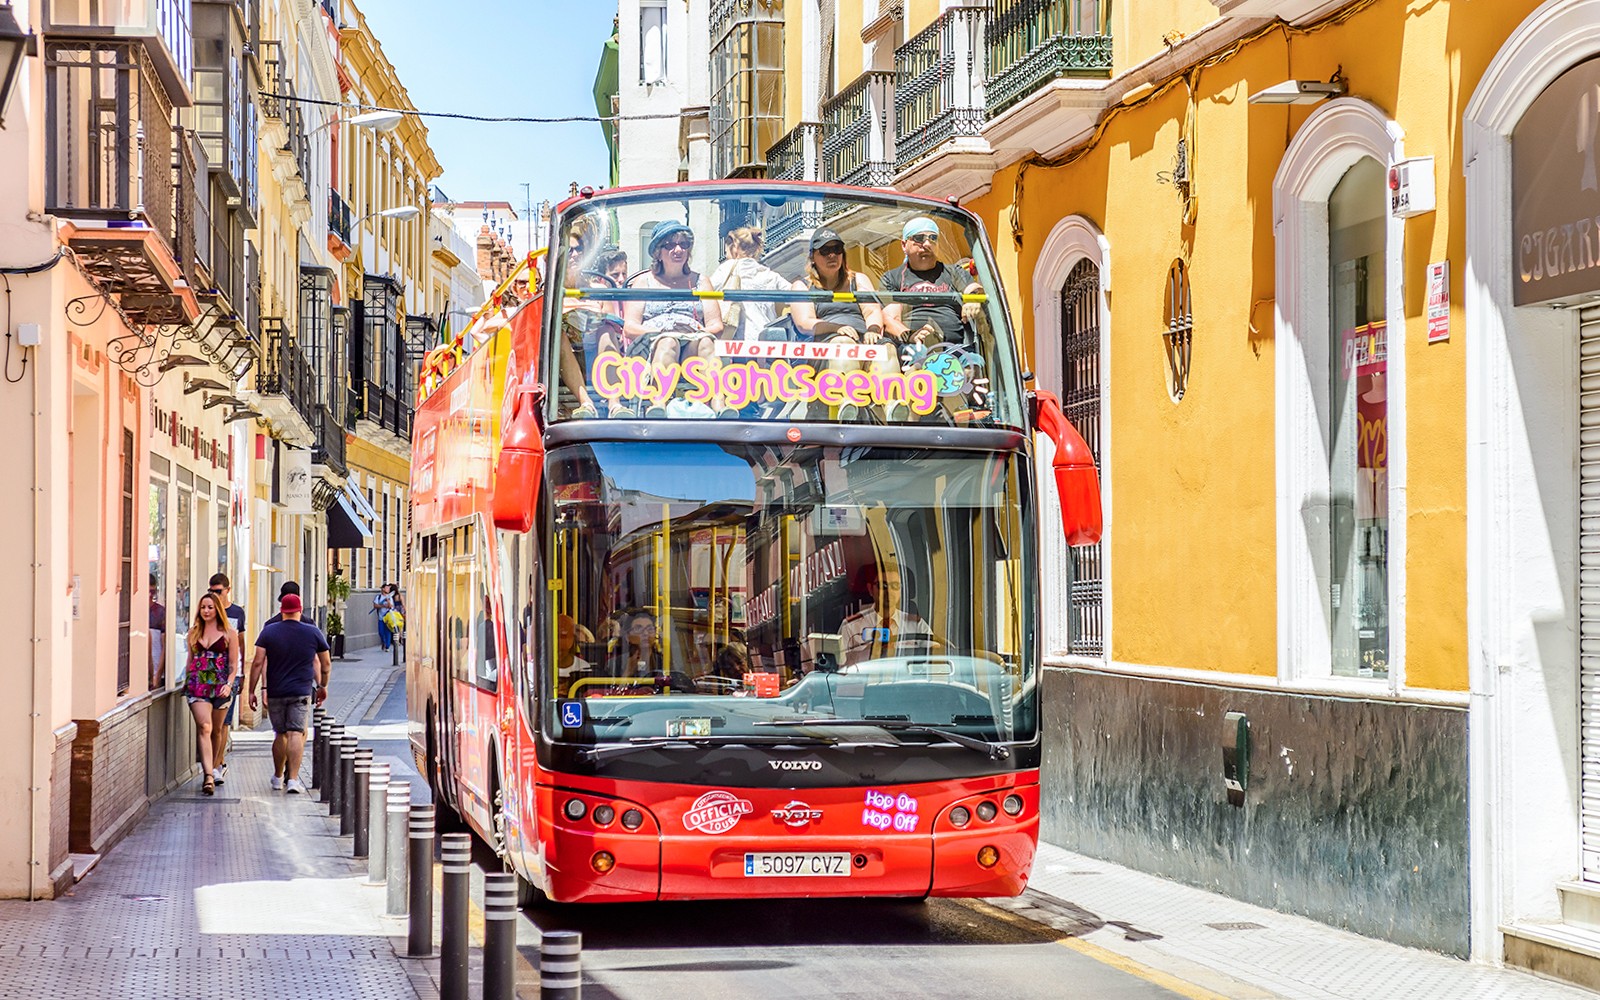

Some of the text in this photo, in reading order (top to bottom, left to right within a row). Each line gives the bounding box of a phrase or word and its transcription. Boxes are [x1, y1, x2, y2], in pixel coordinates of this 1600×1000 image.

[725, 341, 877, 359] Worldwide
[592, 351, 938, 416] City Sightseeing
[768, 760, 822, 771] VOLVO
[865, 790, 918, 811] Hop On
[690, 802, 749, 826] OFFICIAL
[863, 809, 919, 832] Hop Off
[709, 817, 736, 832] TOUR
[762, 856, 844, 874] 5097 CVZ
